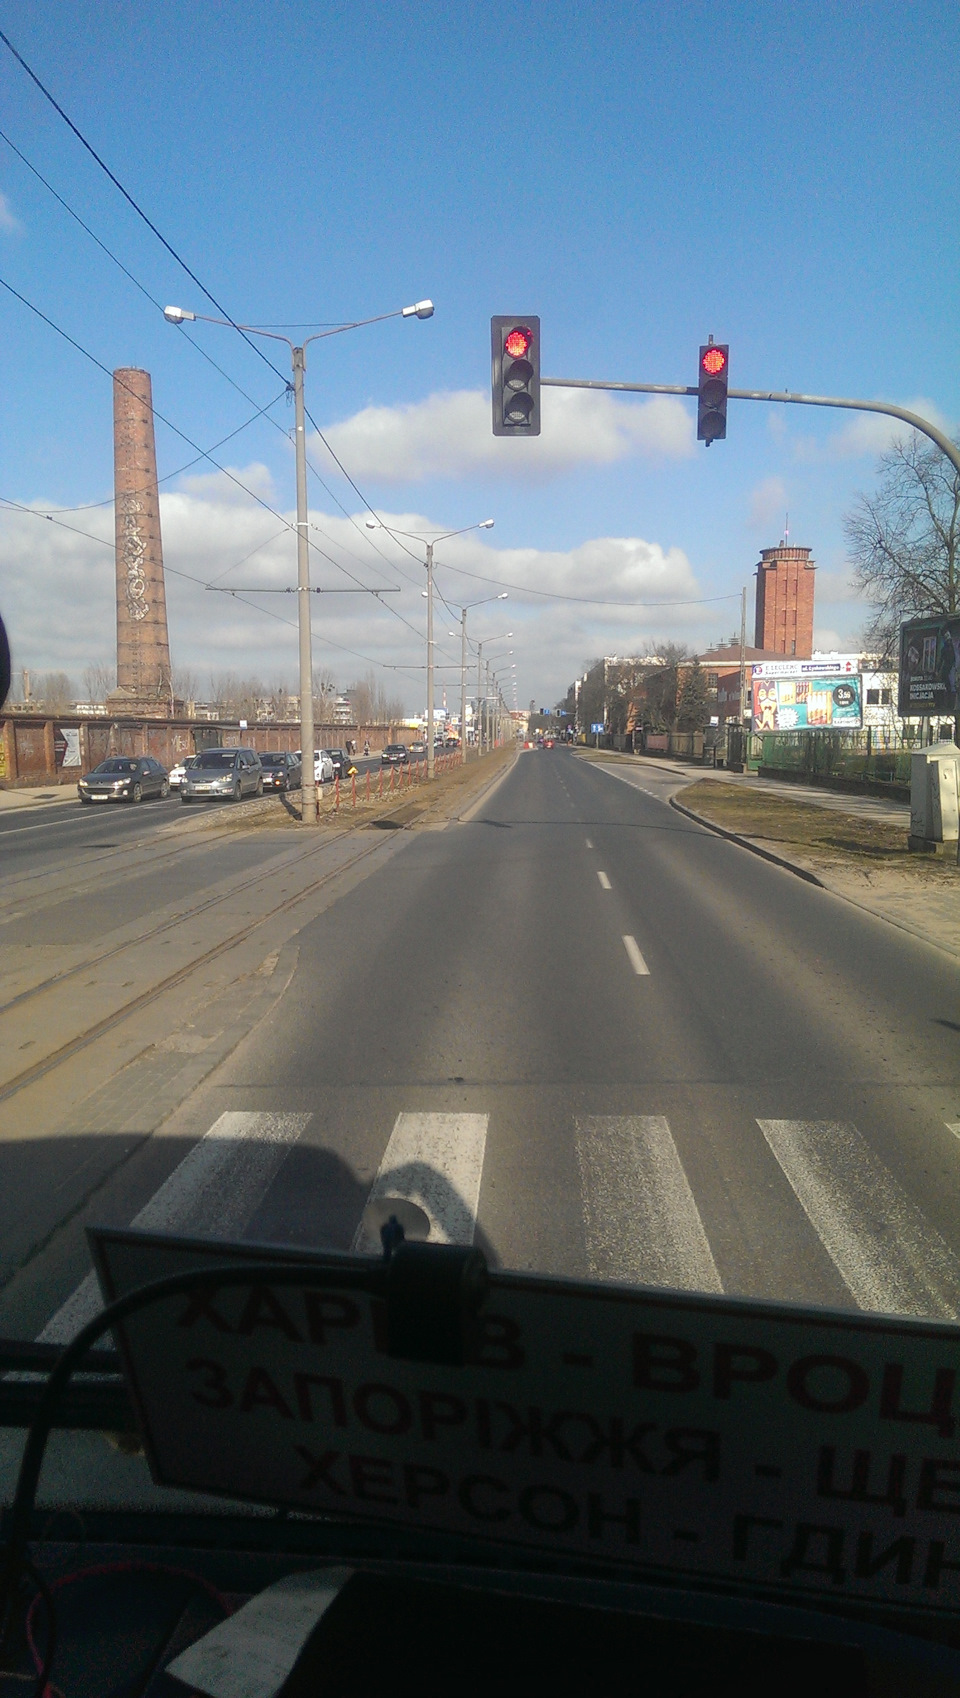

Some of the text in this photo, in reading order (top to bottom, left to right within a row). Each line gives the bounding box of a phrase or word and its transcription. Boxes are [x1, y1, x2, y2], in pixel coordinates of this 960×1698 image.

[177, 1286, 525, 1370] ХАРВ
[185, 1357, 721, 1482] ЗАПОРІЖЖЯ
[293, 1444, 642, 1545] ХЕРСОН
